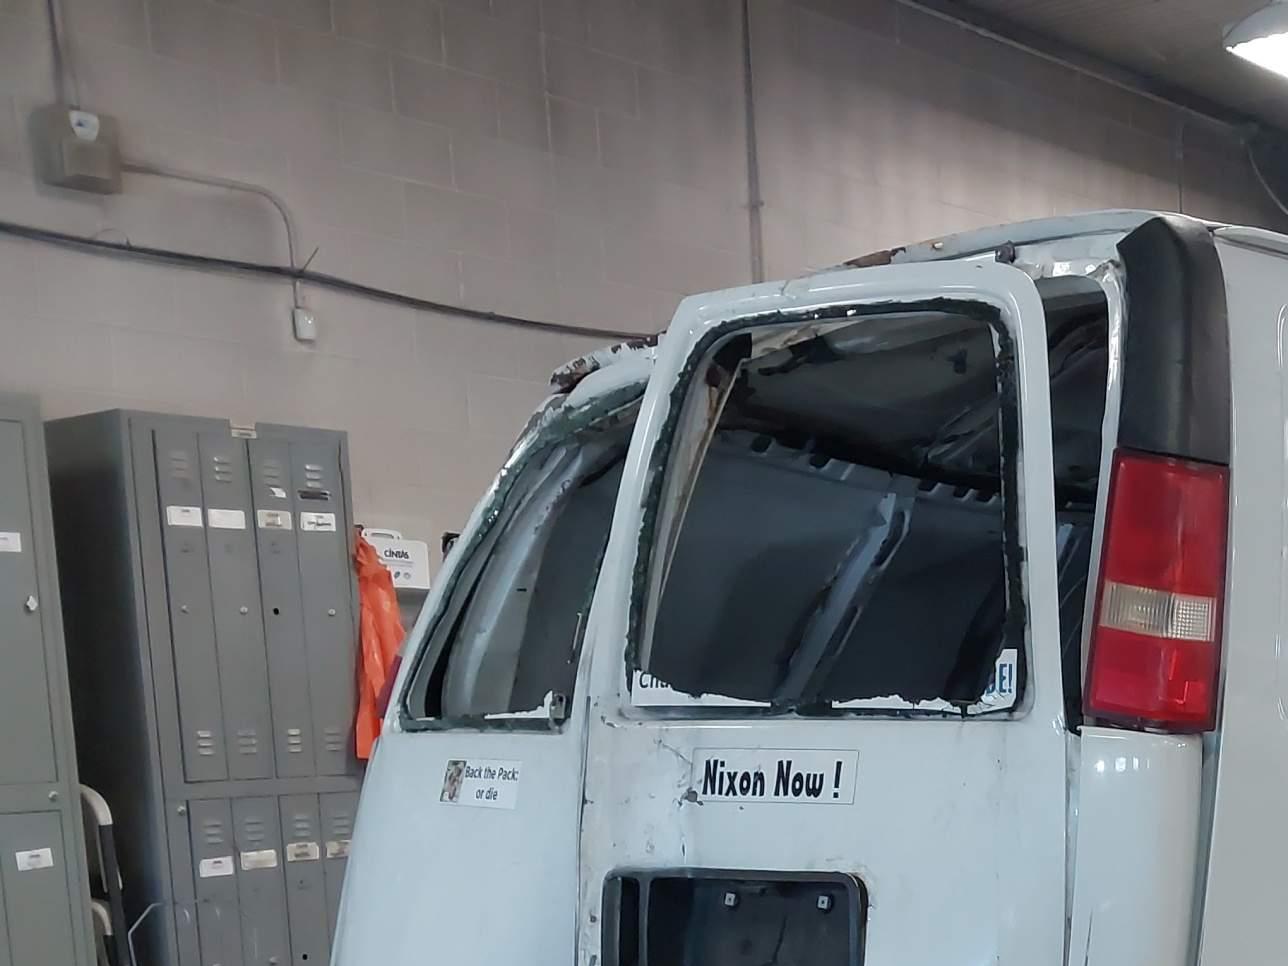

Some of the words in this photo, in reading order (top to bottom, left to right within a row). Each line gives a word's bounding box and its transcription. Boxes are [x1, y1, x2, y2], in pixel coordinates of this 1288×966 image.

[464, 766, 482, 779] Back
[483, 766, 496, 779] the
[702, 759, 765, 797] Nixon
[773, 760, 825, 798] Now
[832, 761, 843, 799] !
[475, 788, 484, 799] or
[485, 787, 498, 800] die
